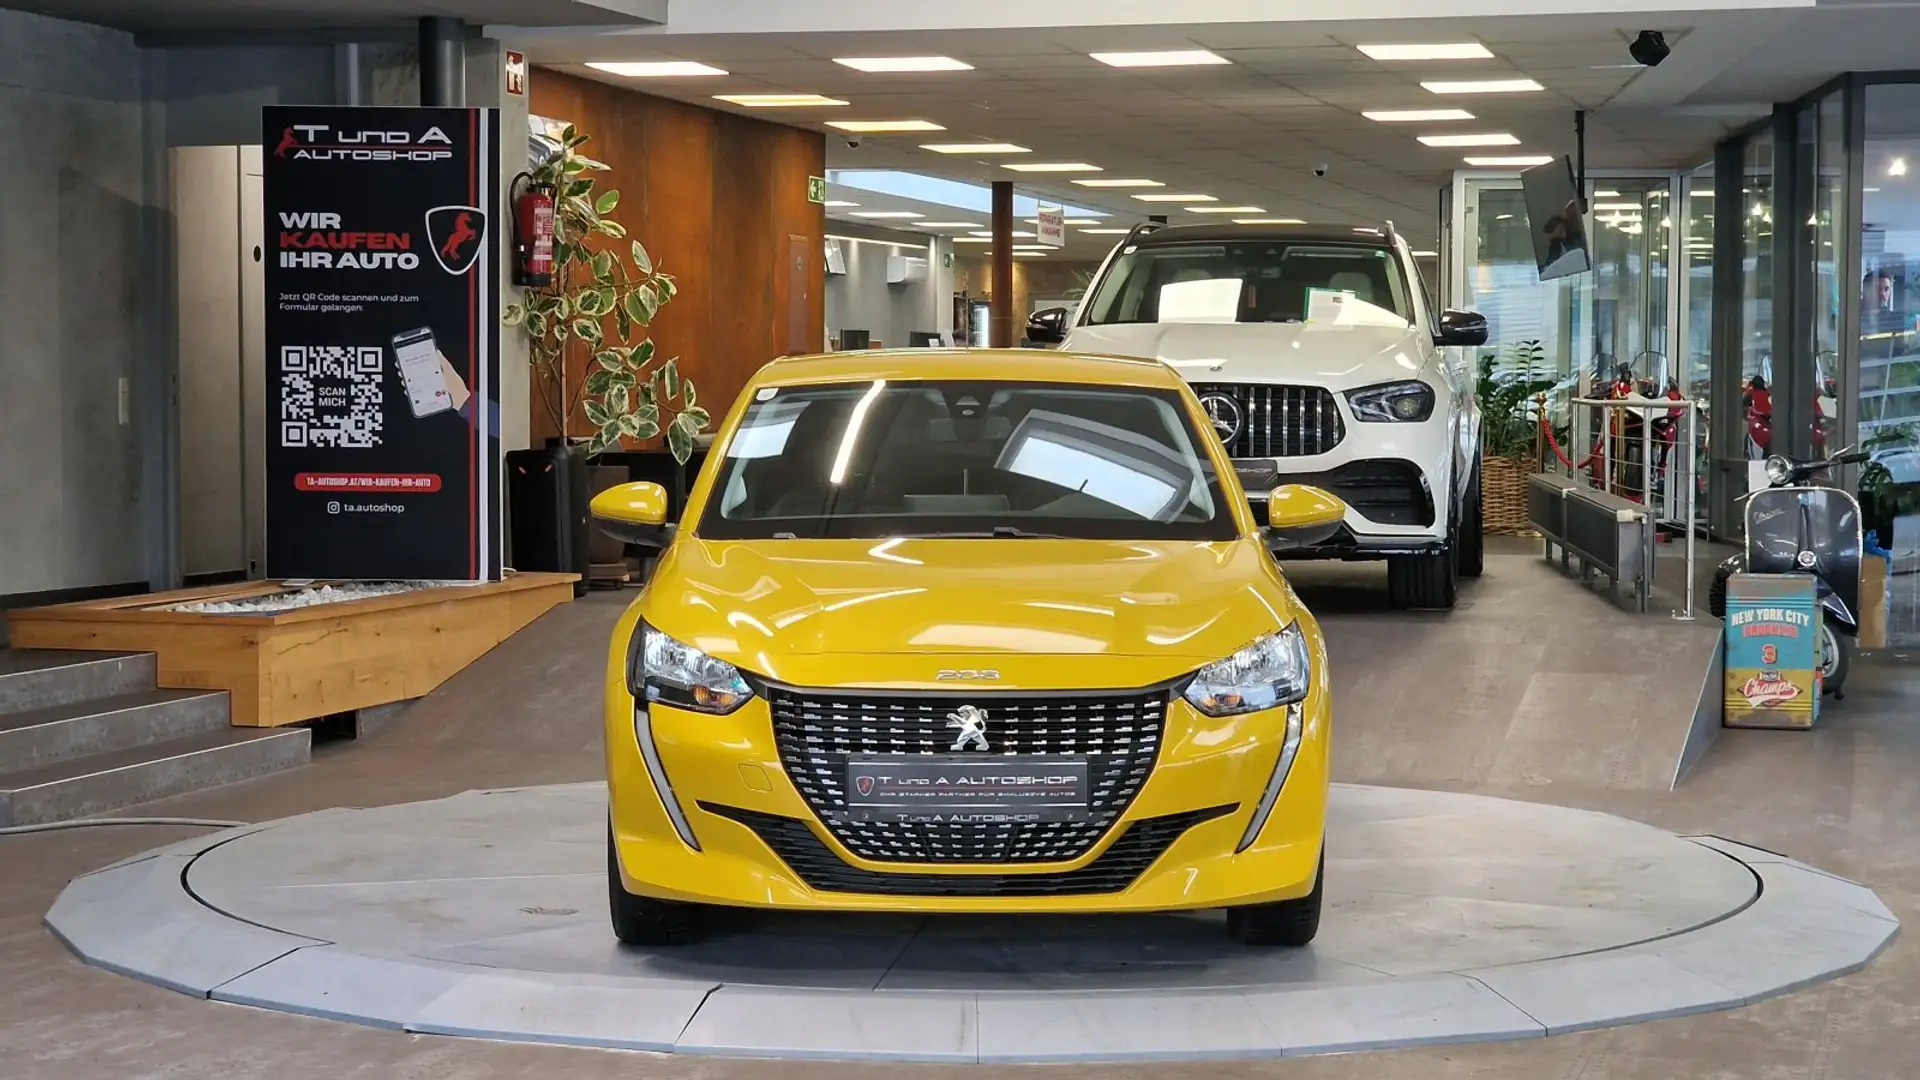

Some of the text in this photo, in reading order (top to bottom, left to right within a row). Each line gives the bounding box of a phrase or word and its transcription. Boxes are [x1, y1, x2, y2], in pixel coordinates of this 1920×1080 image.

[293, 125, 329, 142] T
[418, 126, 452, 144] A
[293, 150, 452, 161] AUTOSHOP
[279, 212, 341, 229] WIR
[280, 232, 410, 249] KAUFEN
[280, 252, 419, 270] IHR AUTO
[279, 292, 300, 300] Jetzt
[302, 293, 316, 301] QR
[318, 293, 340, 301] Code
[381, 294, 398, 302] und
[280, 302, 319, 311] Formular
[319, 387, 346, 396] SCAN
[319, 397, 346, 406] MICH
[344, 503, 405, 514] ta.autoshop
[1732, 608, 1810, 627] NEW YORK CITY
[937, 669, 1000, 681] 208
[1744, 678, 1793, 698] Champs
[878, 776, 892, 784] T
[936, 777, 949, 785] A
[956, 776, 1078, 785] AUTOSHOP
[897, 813, 908, 822] T
[933, 814, 944, 822] A
[950, 813, 1040, 823] AUTOSHOP
